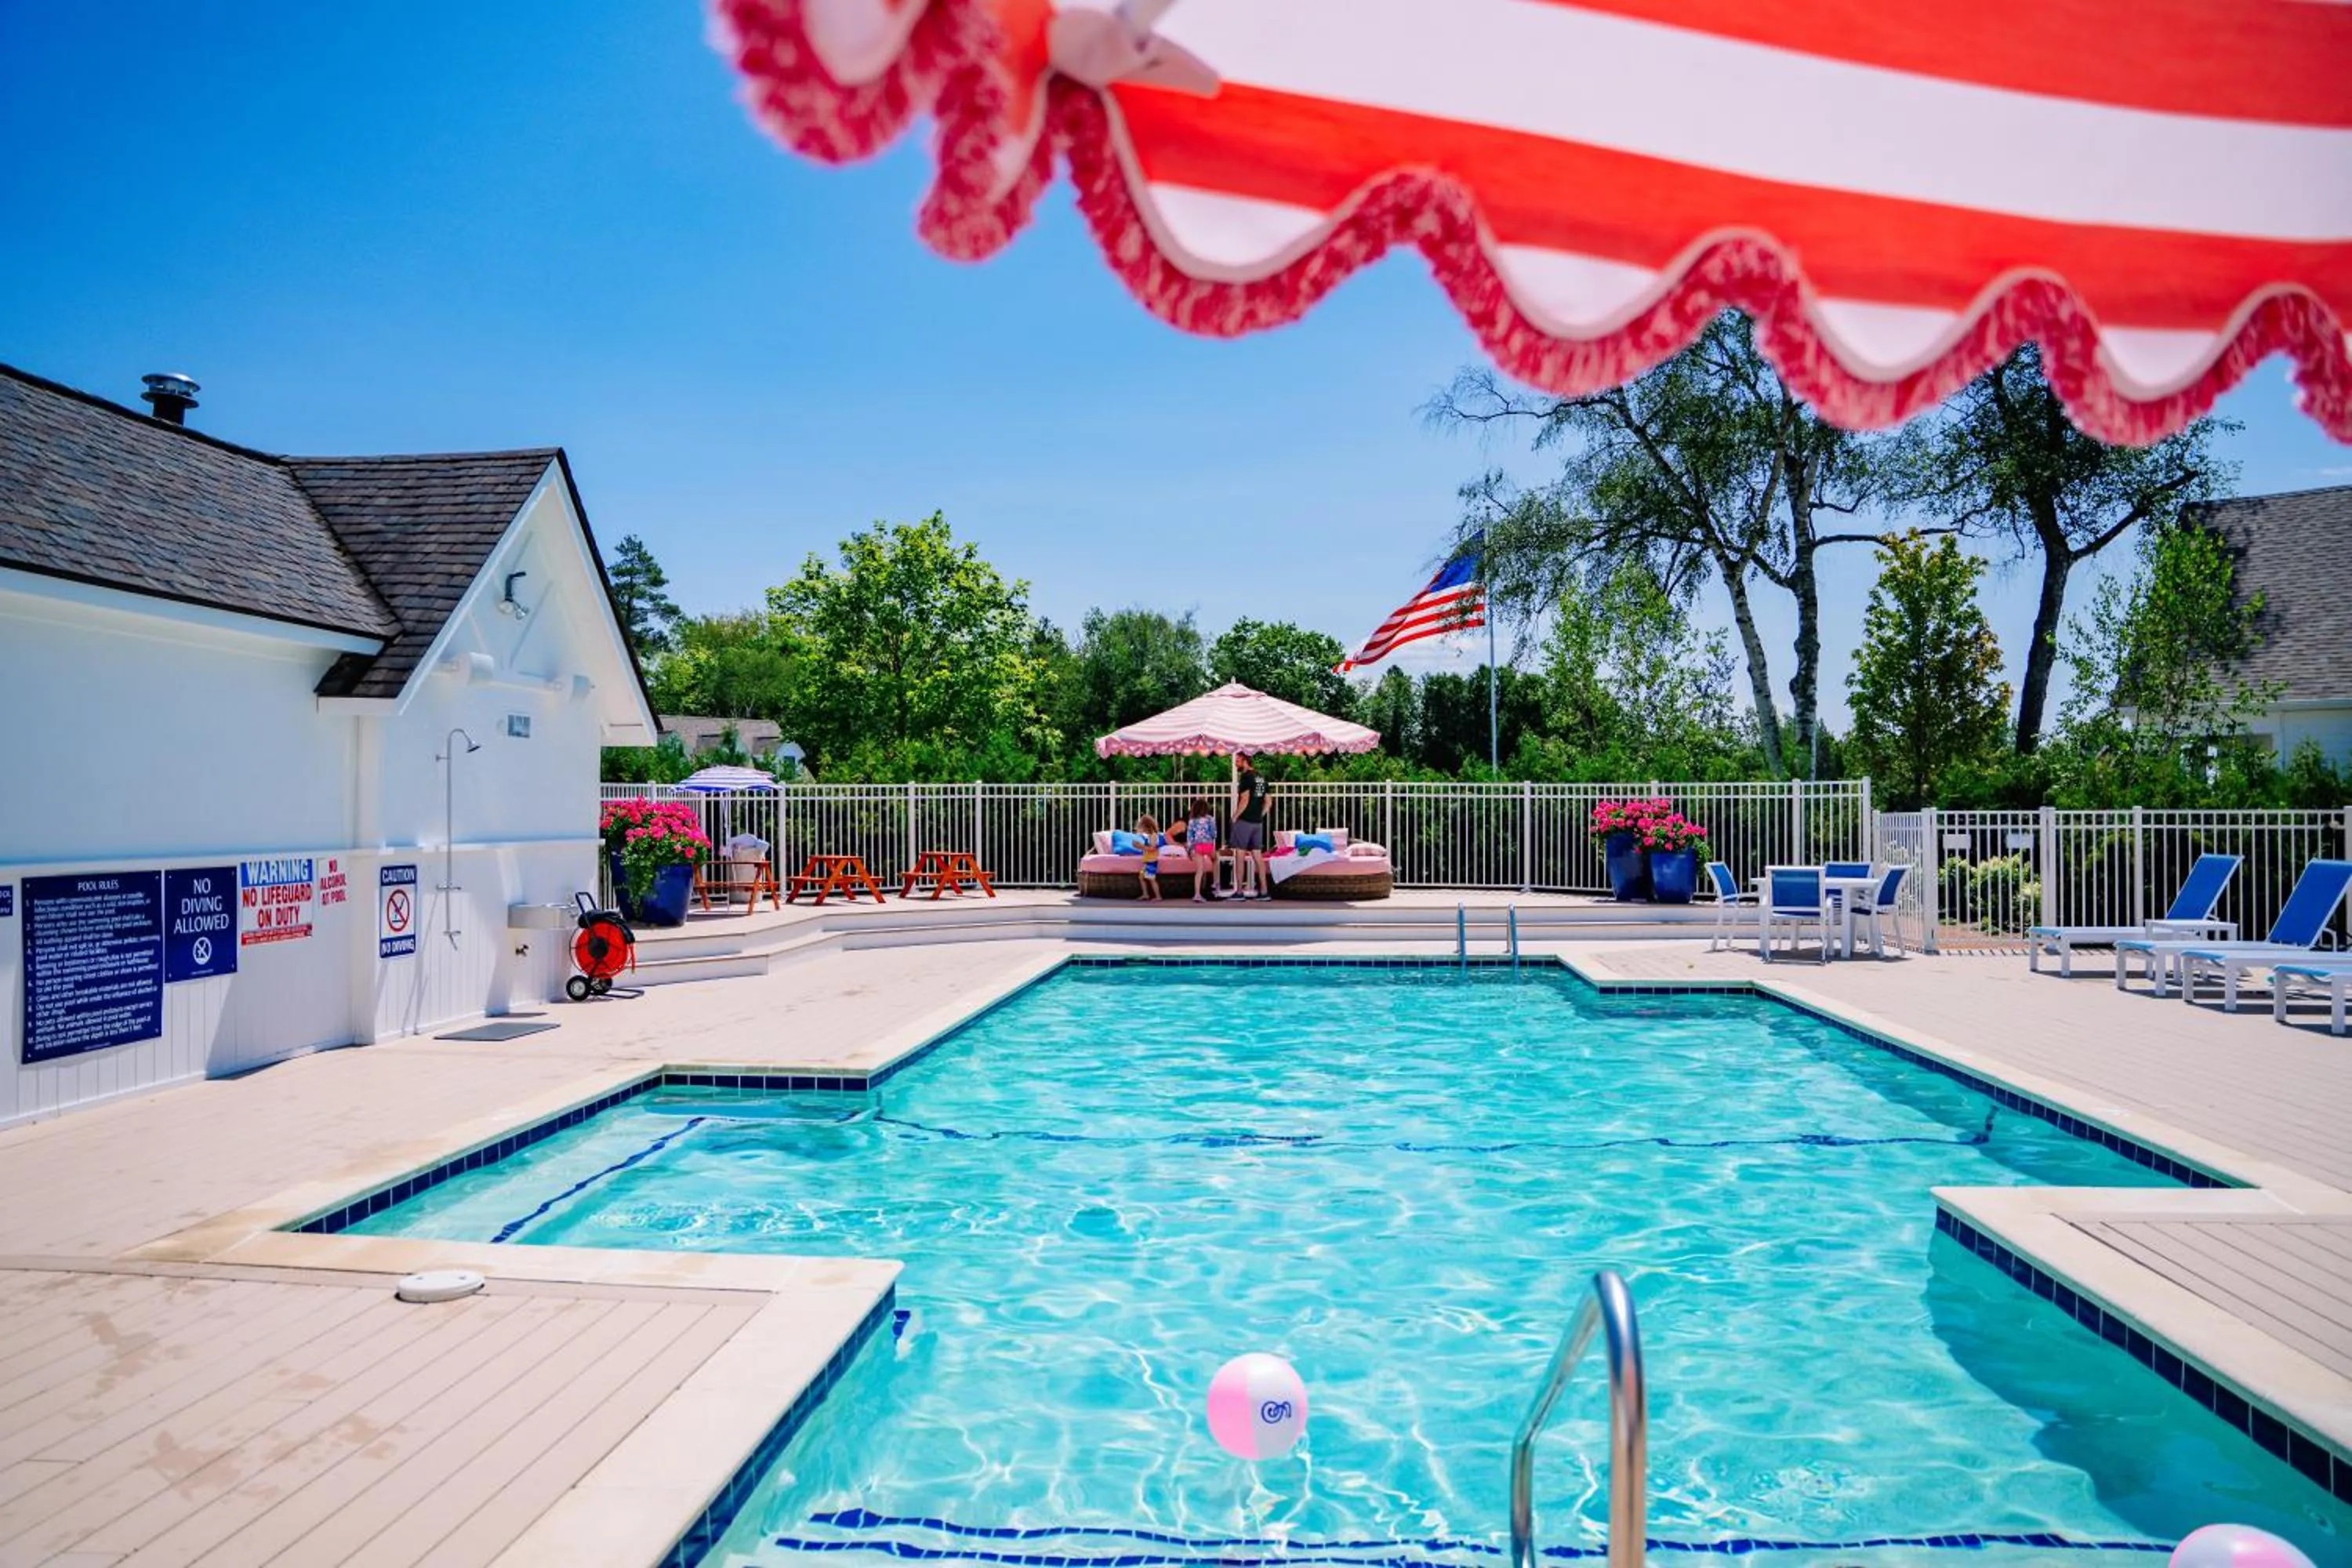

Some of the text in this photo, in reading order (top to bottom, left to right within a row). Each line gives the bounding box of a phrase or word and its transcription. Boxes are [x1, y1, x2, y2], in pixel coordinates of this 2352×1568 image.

[247, 859, 308, 885] WARNING
[329, 859, 337, 873] NO
[78, 879, 119, 891] POOL RULES
[194, 877, 211, 895] NO
[321, 873, 347, 891] ALCOHOL
[383, 869, 415, 884] CAUTION
[181, 895, 223, 915] DIVING
[242, 884, 312, 907] NO LIFEGUARD
[173, 913, 230, 935] ALLOWED
[258, 906, 300, 927] ON DUTY
